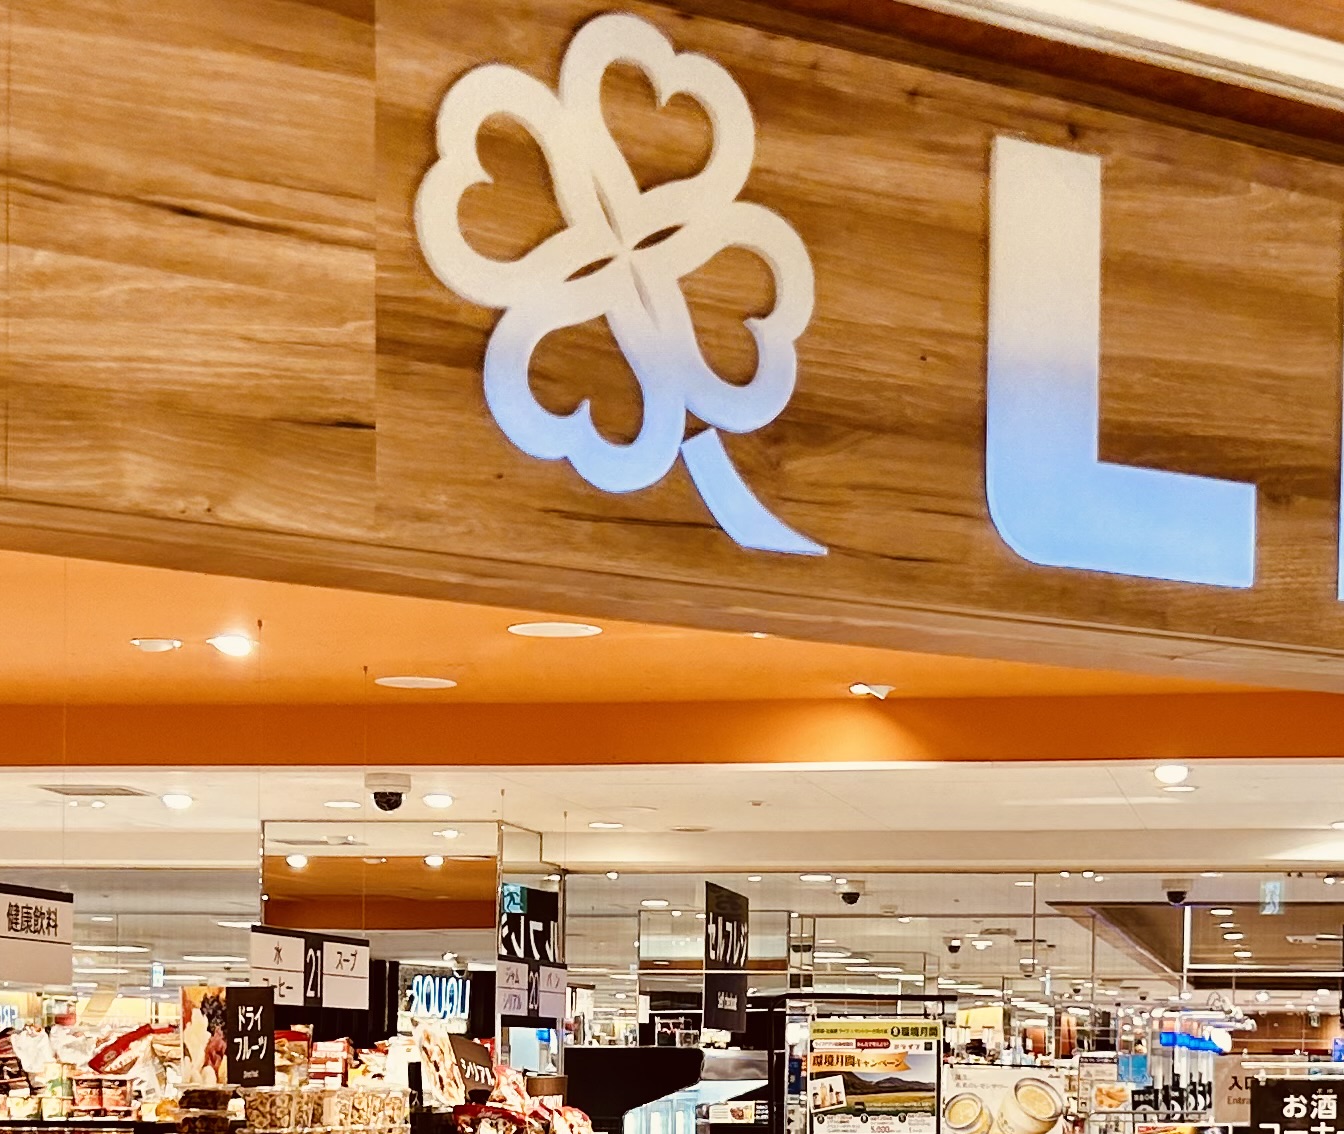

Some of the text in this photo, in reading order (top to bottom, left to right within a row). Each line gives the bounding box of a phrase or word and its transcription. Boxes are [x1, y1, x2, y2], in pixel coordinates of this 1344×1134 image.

[6, 901, 58, 936] 健康飲料
[707, 911, 748, 968] セルフレジ
[306, 948, 321, 998] 21
[335, 950, 358, 972] スープ
[238, 1005, 263, 1032] ドライ
[233, 1035, 268, 1062] フルーツ
[1282, 1094, 1338, 1121] お酒
